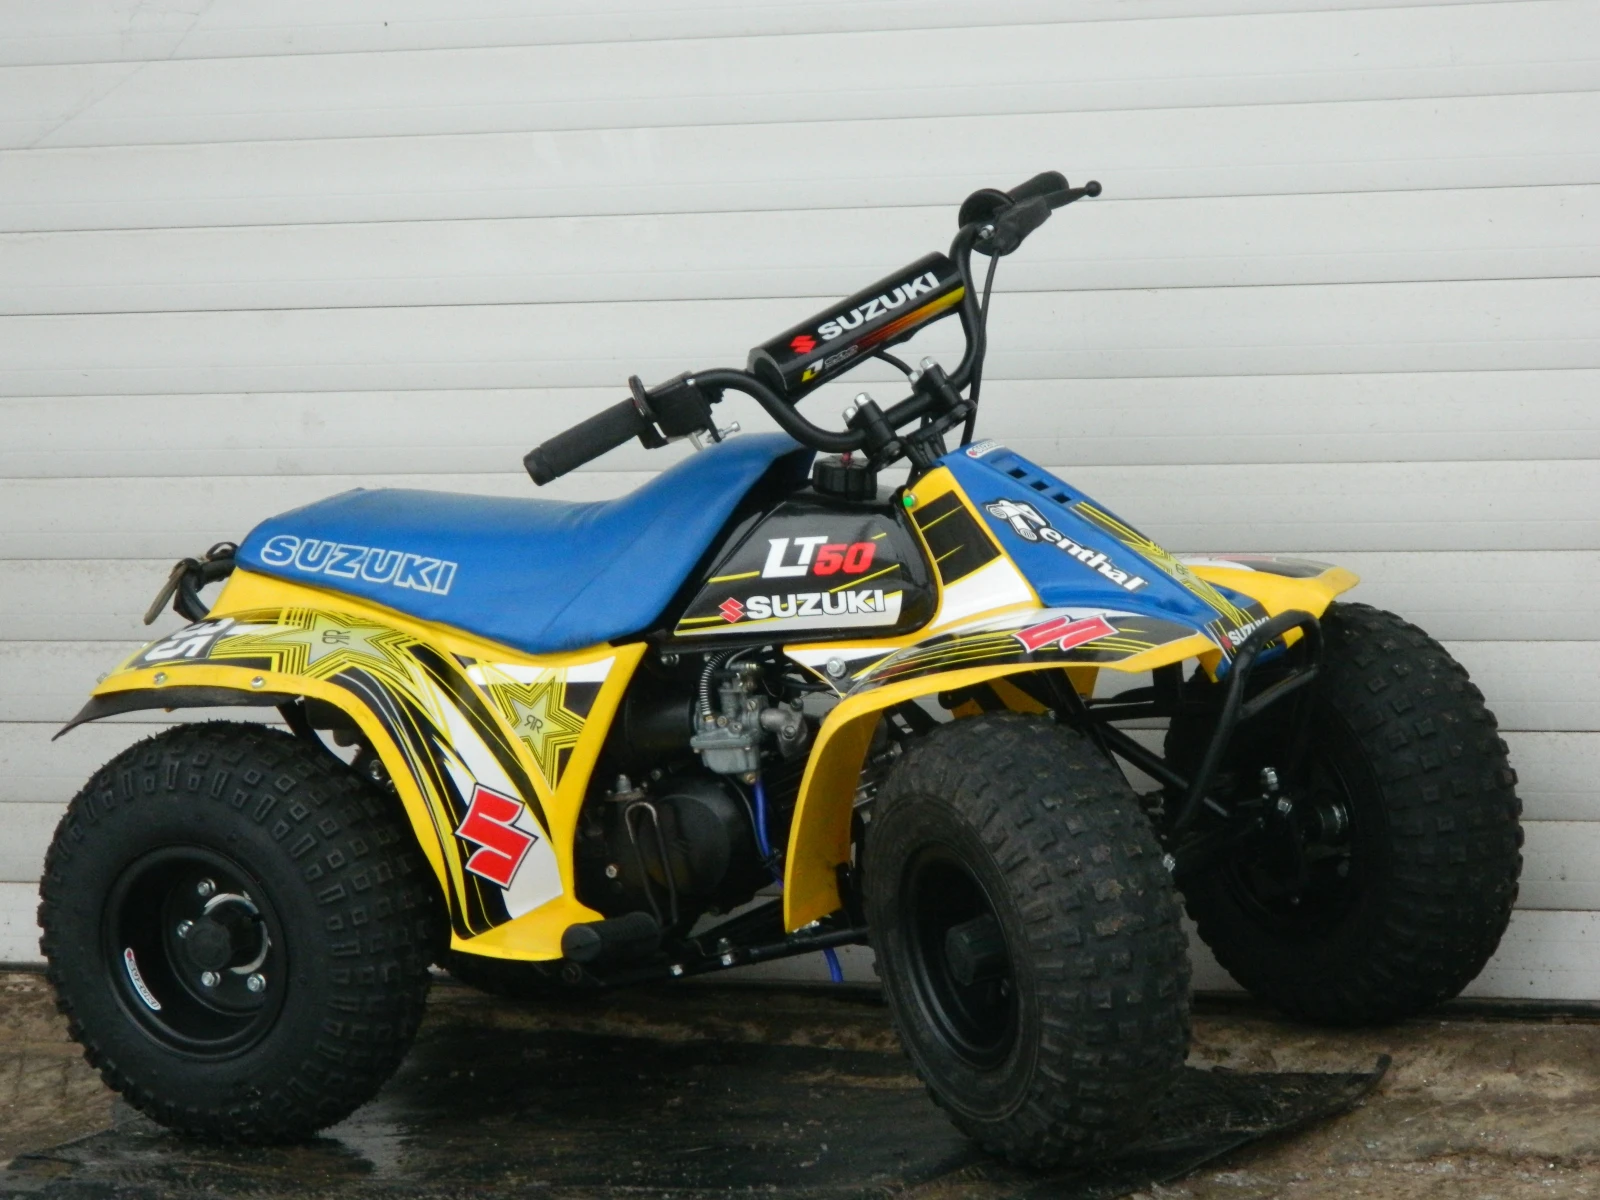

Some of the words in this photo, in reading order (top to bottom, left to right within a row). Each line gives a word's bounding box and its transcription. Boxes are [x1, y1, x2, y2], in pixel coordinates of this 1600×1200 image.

[817, 272, 940, 340] SUZUKI
[260, 535, 458, 595] SUZUKI
[762, 536, 876, 578] LT50
[746, 589, 887, 620] SUZUKI
